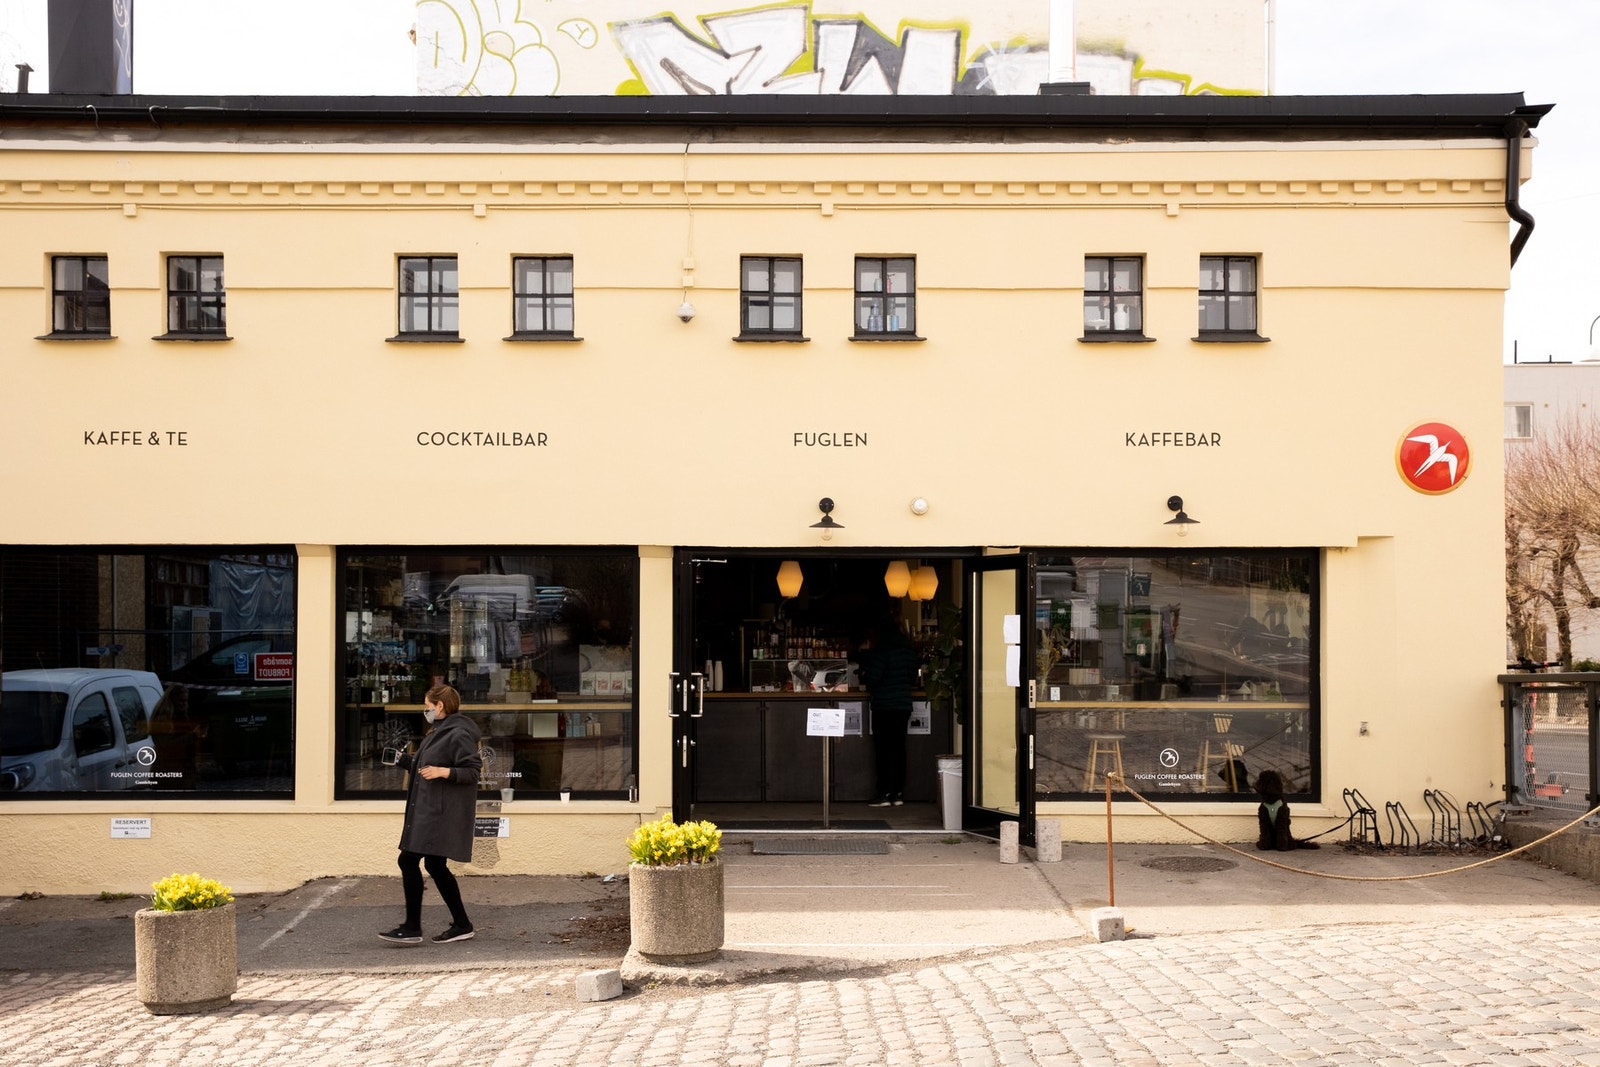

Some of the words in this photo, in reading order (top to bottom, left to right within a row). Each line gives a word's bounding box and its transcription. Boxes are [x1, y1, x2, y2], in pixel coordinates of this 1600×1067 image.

[84, 430, 143, 446] KAFFE
[148, 430, 160, 446] &
[165, 430, 188, 446] TE
[416, 431, 548, 447] COCKTAILBAR
[793, 432, 868, 447] FUGLEN
[1125, 432, 1221, 447] KAFFEBAR
